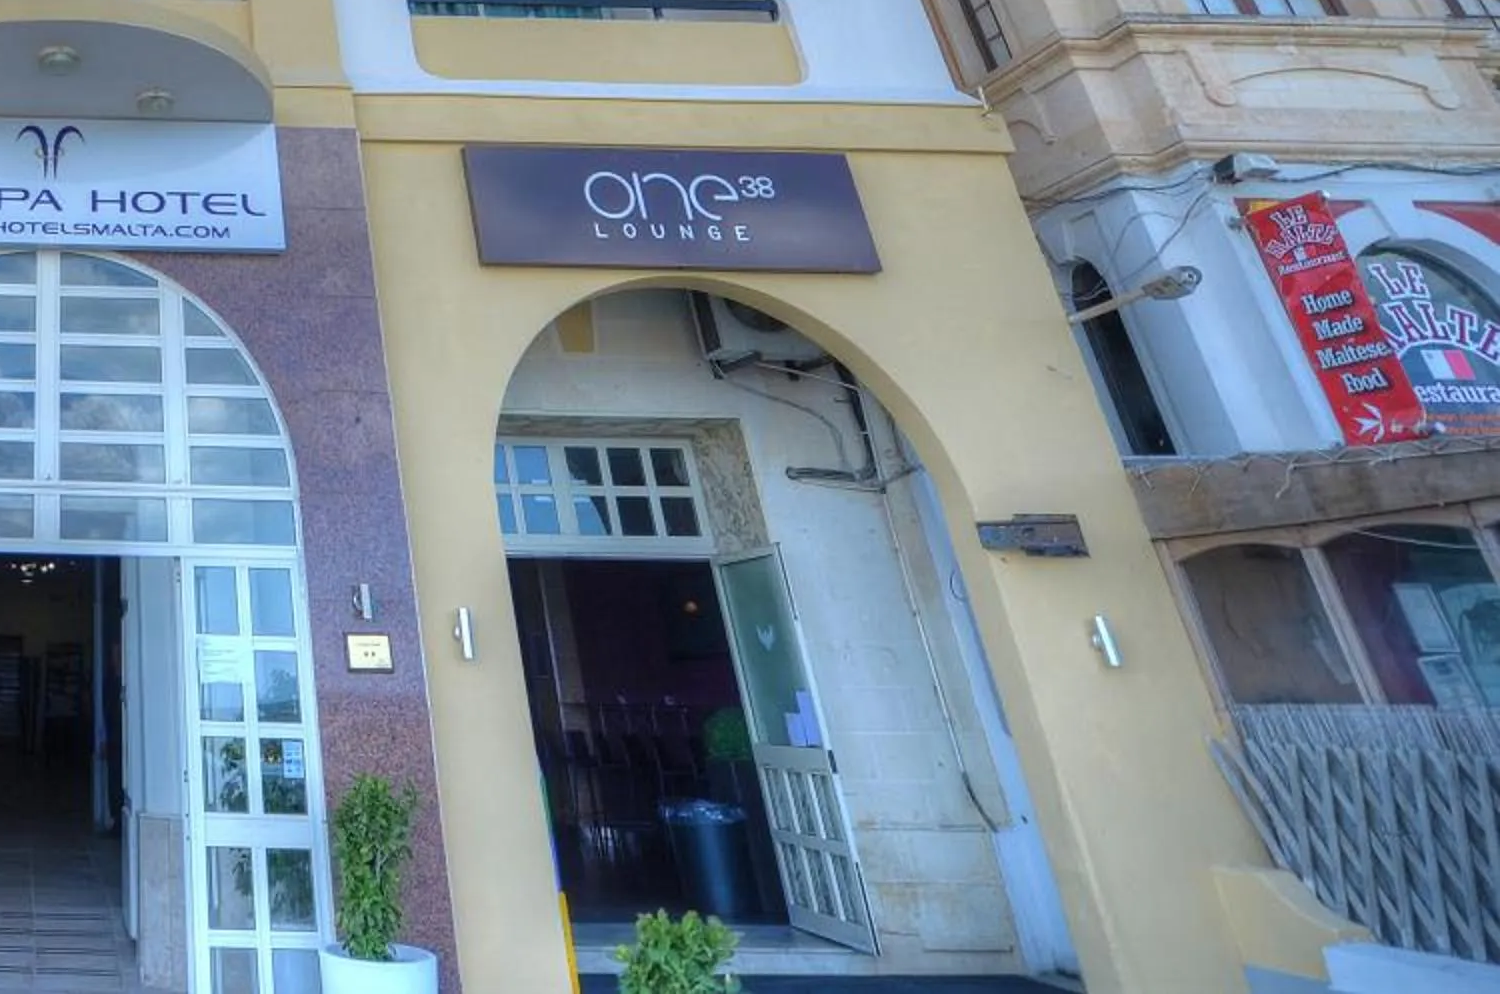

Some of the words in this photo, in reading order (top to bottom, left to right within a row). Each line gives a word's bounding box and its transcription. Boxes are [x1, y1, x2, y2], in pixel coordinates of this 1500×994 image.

[91, 190, 268, 217] HOTEL
[594, 222, 750, 242] LOUNGE
[1368, 261, 1431, 300] LE
[1300, 289, 1354, 315] Home
[1312, 315, 1364, 341] Made
[1315, 341, 1388, 370] Maltese
[1340, 367, 1388, 395] Food
[1413, 381, 1500, 403] estaura
